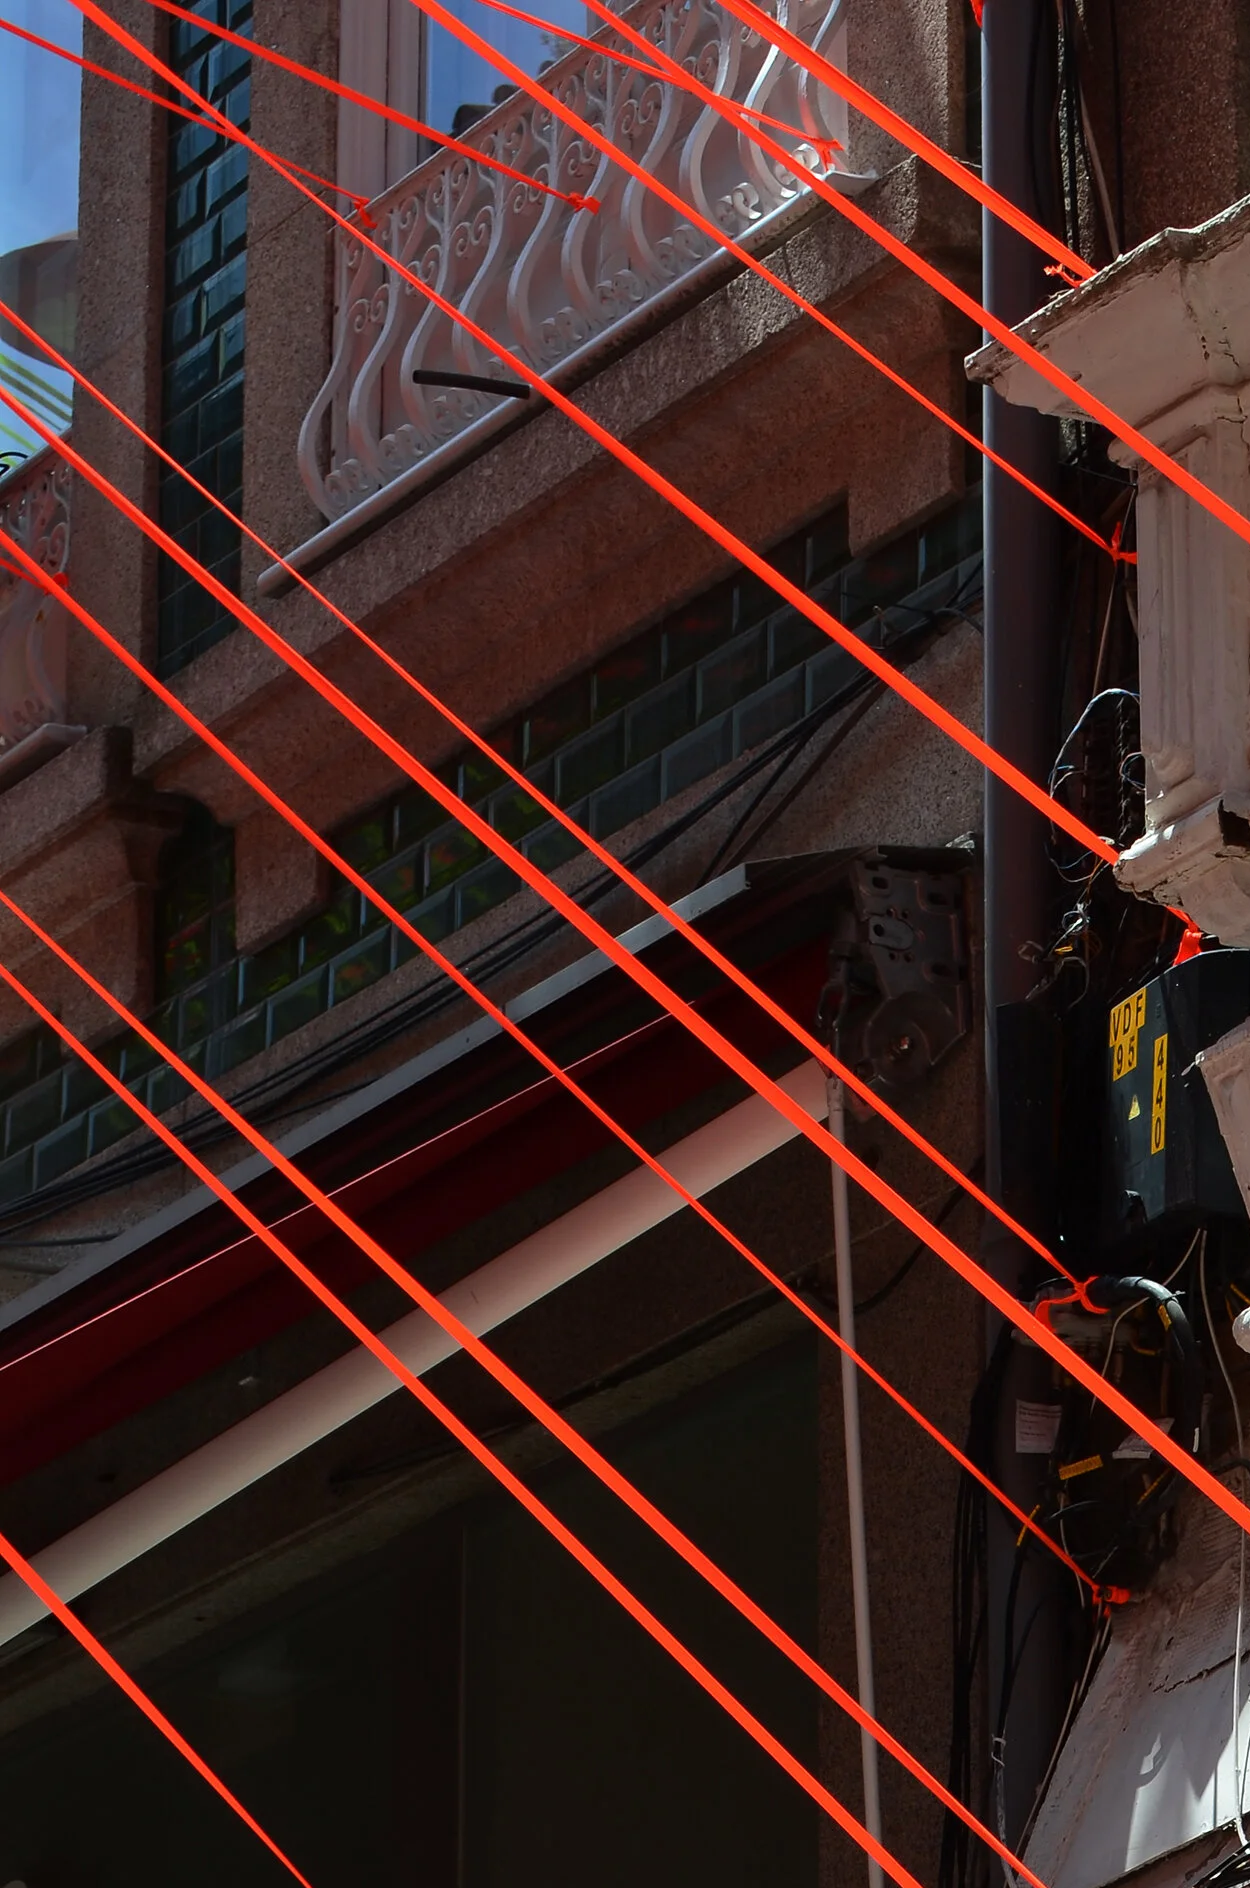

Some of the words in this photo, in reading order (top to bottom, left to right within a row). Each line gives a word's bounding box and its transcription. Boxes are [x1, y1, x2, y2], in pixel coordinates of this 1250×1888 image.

[1112, 992, 1144, 1042] VDF
[1115, 1034, 1136, 1076] 95
[1153, 1036, 1166, 1151] 440
